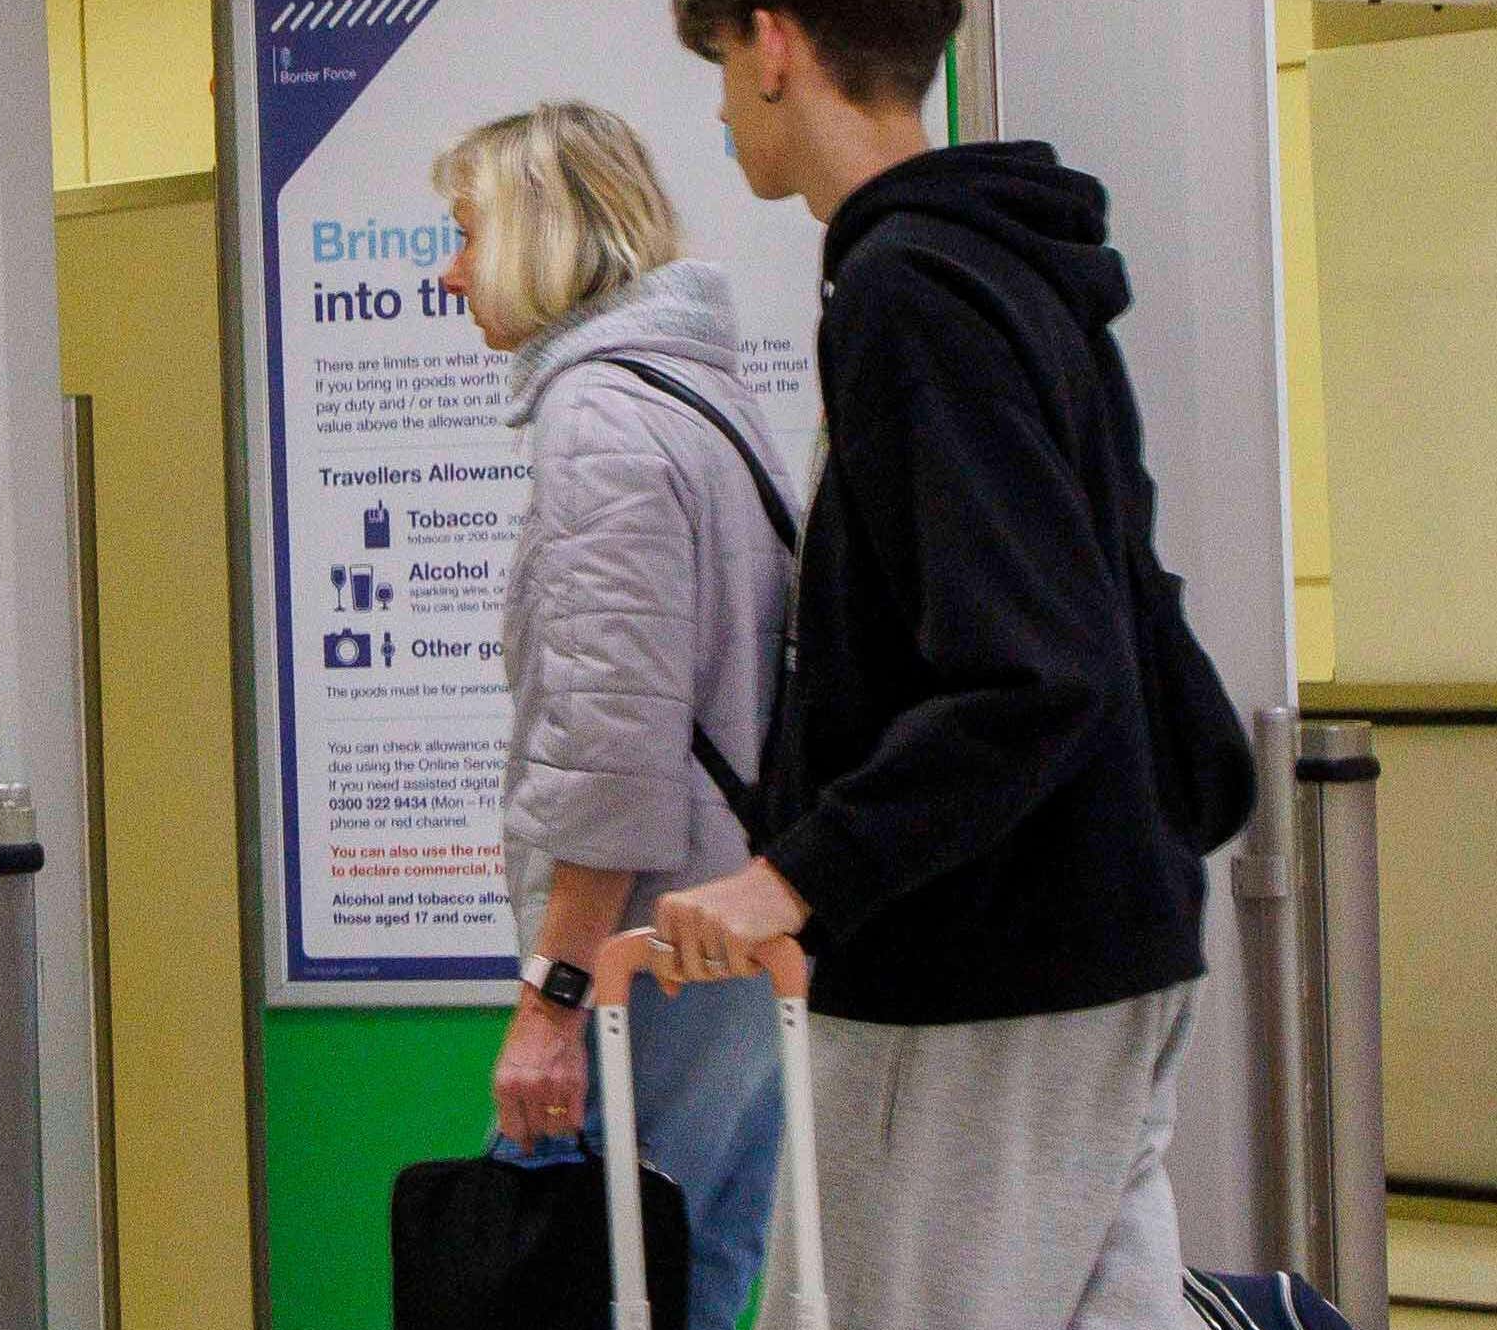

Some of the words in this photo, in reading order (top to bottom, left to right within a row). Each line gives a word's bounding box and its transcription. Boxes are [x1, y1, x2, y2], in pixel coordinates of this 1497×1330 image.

[280, 69, 321, 84] Border
[323, 67, 356, 81] Force
[313, 215, 463, 267] Bringi
[314, 282, 402, 323] into
[417, 277, 466, 317] th
[315, 358, 355, 372] There
[356, 359, 380, 371] are
[382, 355, 420, 370] limits
[421, 357, 443, 368] on
[444, 352, 480, 367] what
[481, 354, 508, 369] you
[315, 379, 325, 393] If
[326, 381, 353, 396] you
[355, 377, 393, 393] bring
[394, 376, 409, 390] in
[410, 374, 457, 392] goods
[458, 371, 500, 387] worth
[319, 466, 422, 487] Travellers
[428, 464, 535, 483] Allowance
[408, 509, 498, 529] Tobacco
[408, 561, 489, 581] Alcohol
[411, 638, 472, 658] Other
[328, 797, 363, 811] 0300
[366, 797, 391, 810] 322
[394, 796, 428, 810] 9434
[331, 892, 385, 907] Alcohol
[386, 892, 415, 905] and
[416, 891, 475, 905] tobacco
[333, 911, 372, 925] those
[373, 911, 411, 927] aged
[412, 910, 430, 924] 17
[431, 910, 460, 924] and
